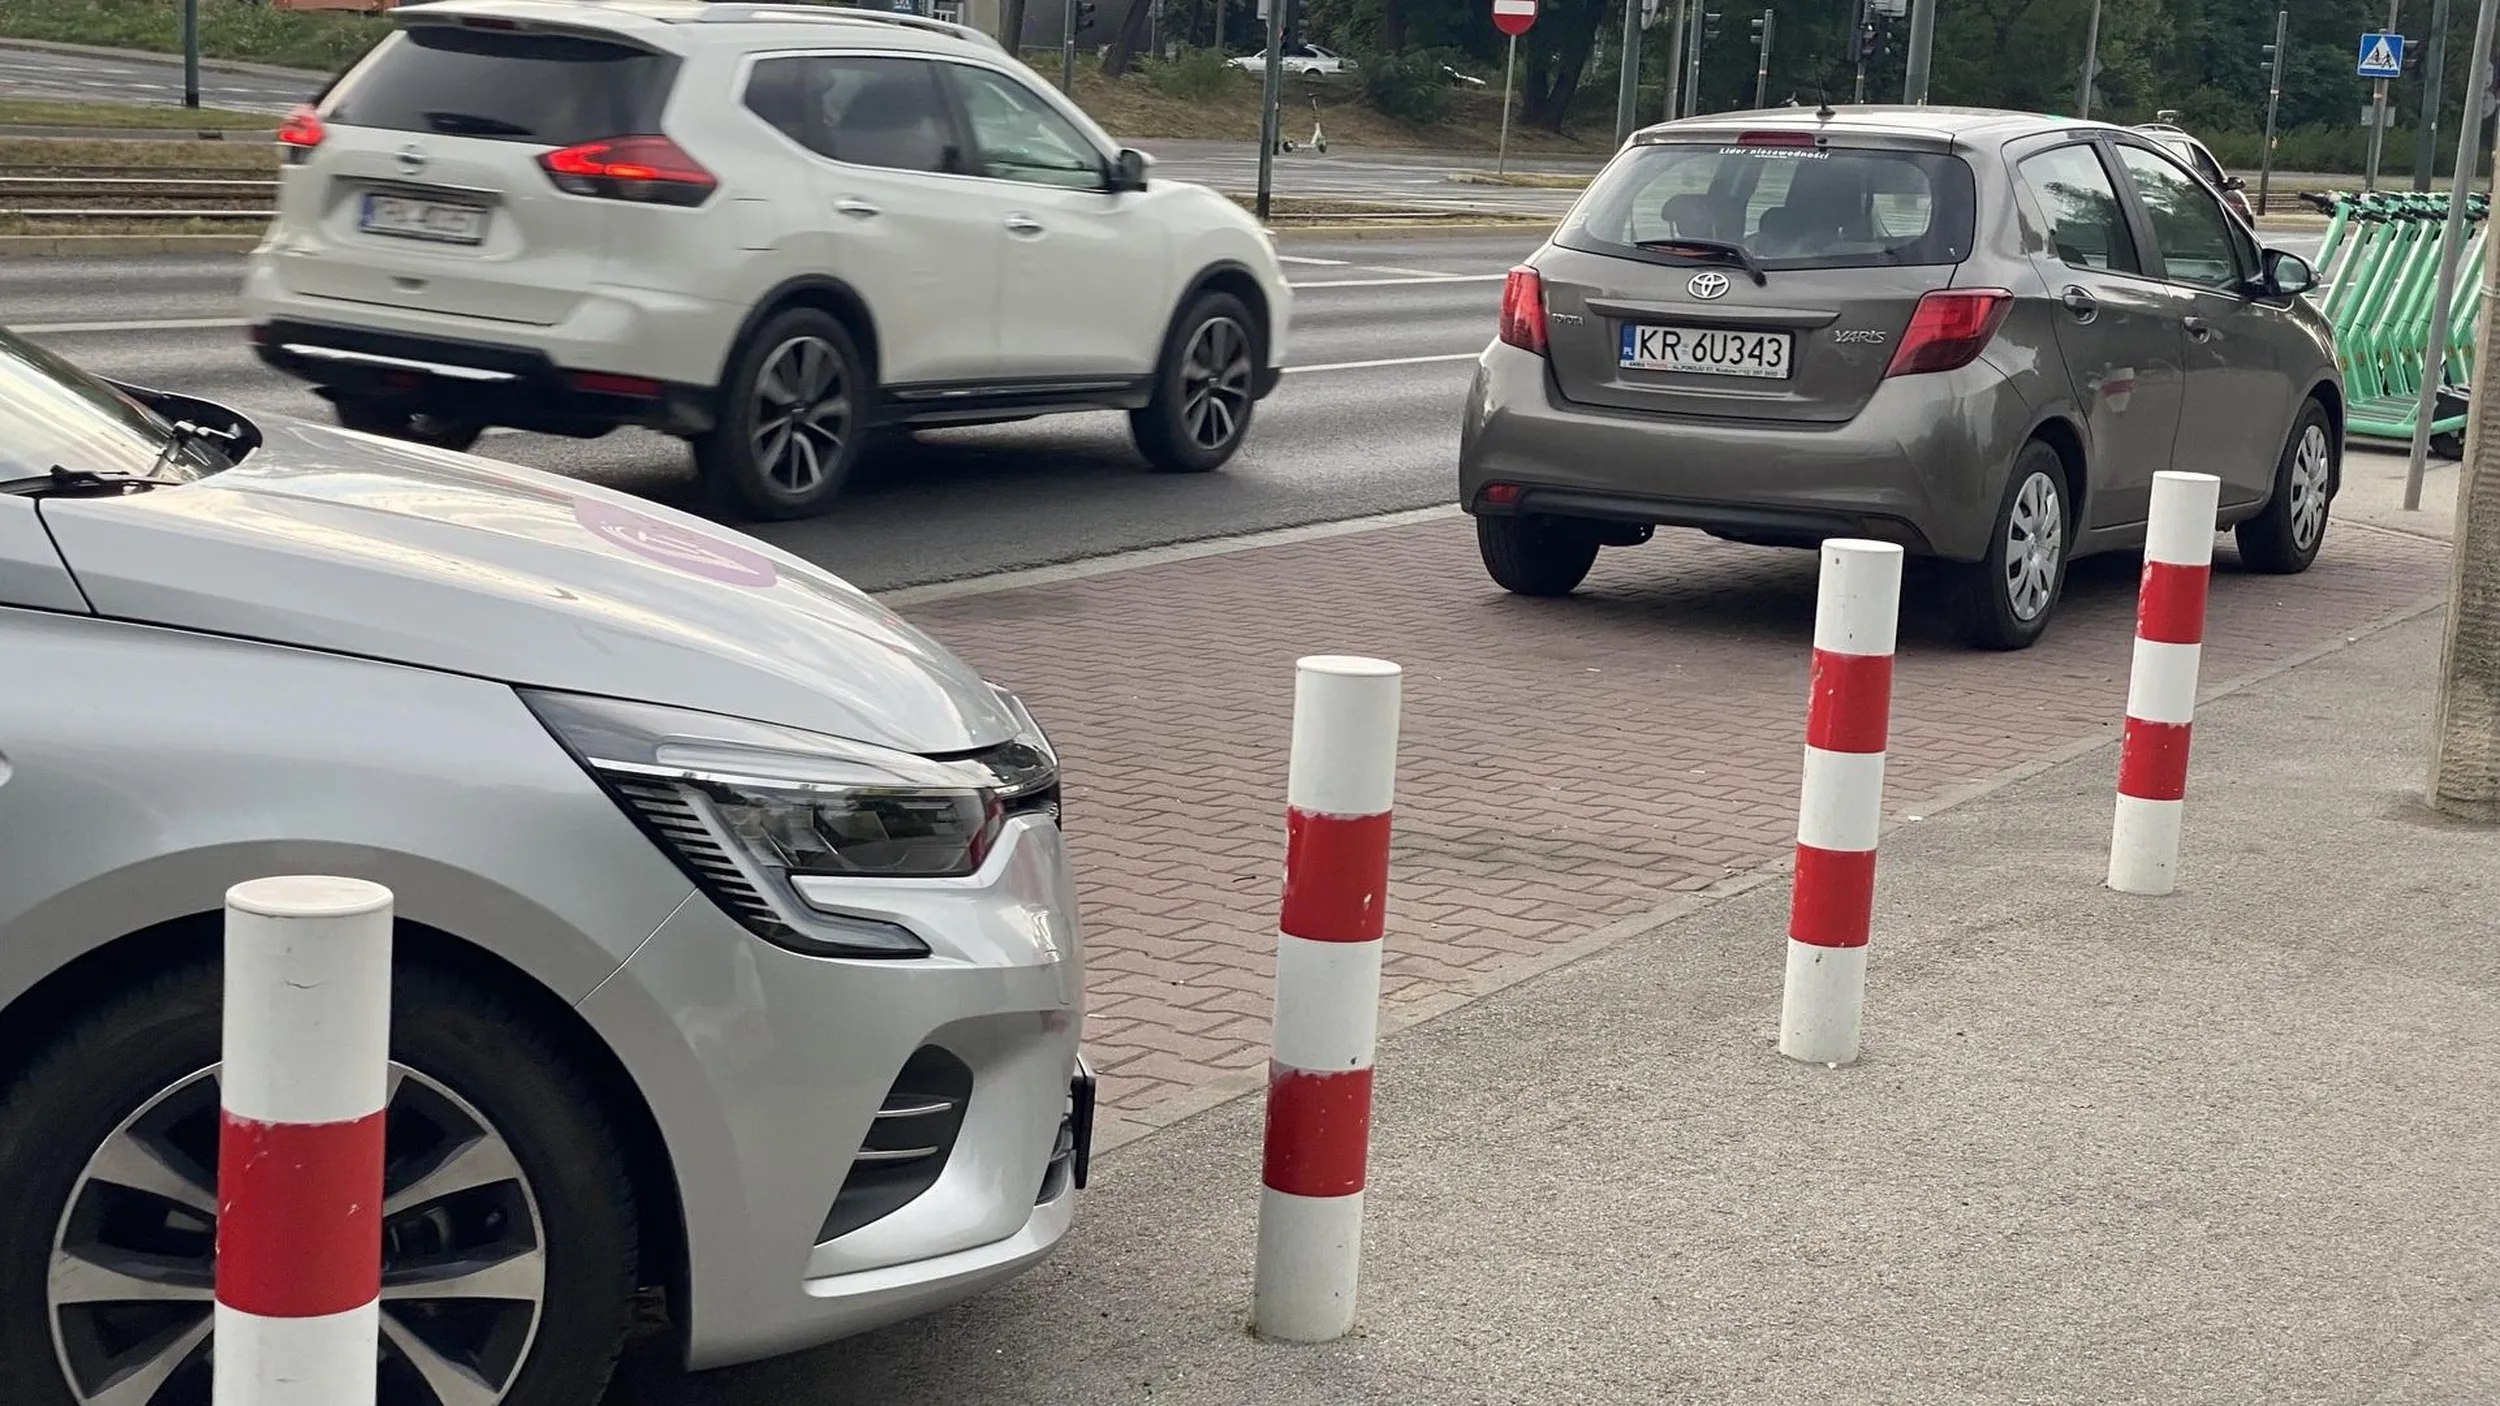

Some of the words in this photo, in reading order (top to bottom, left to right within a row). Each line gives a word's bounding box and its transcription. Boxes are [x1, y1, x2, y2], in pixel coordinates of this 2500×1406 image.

[1719, 147, 1747, 156] Lider
[1834, 330, 1887, 344] YARIS
[1639, 329, 1682, 361] KR
[1691, 332, 1783, 367] 6U343
